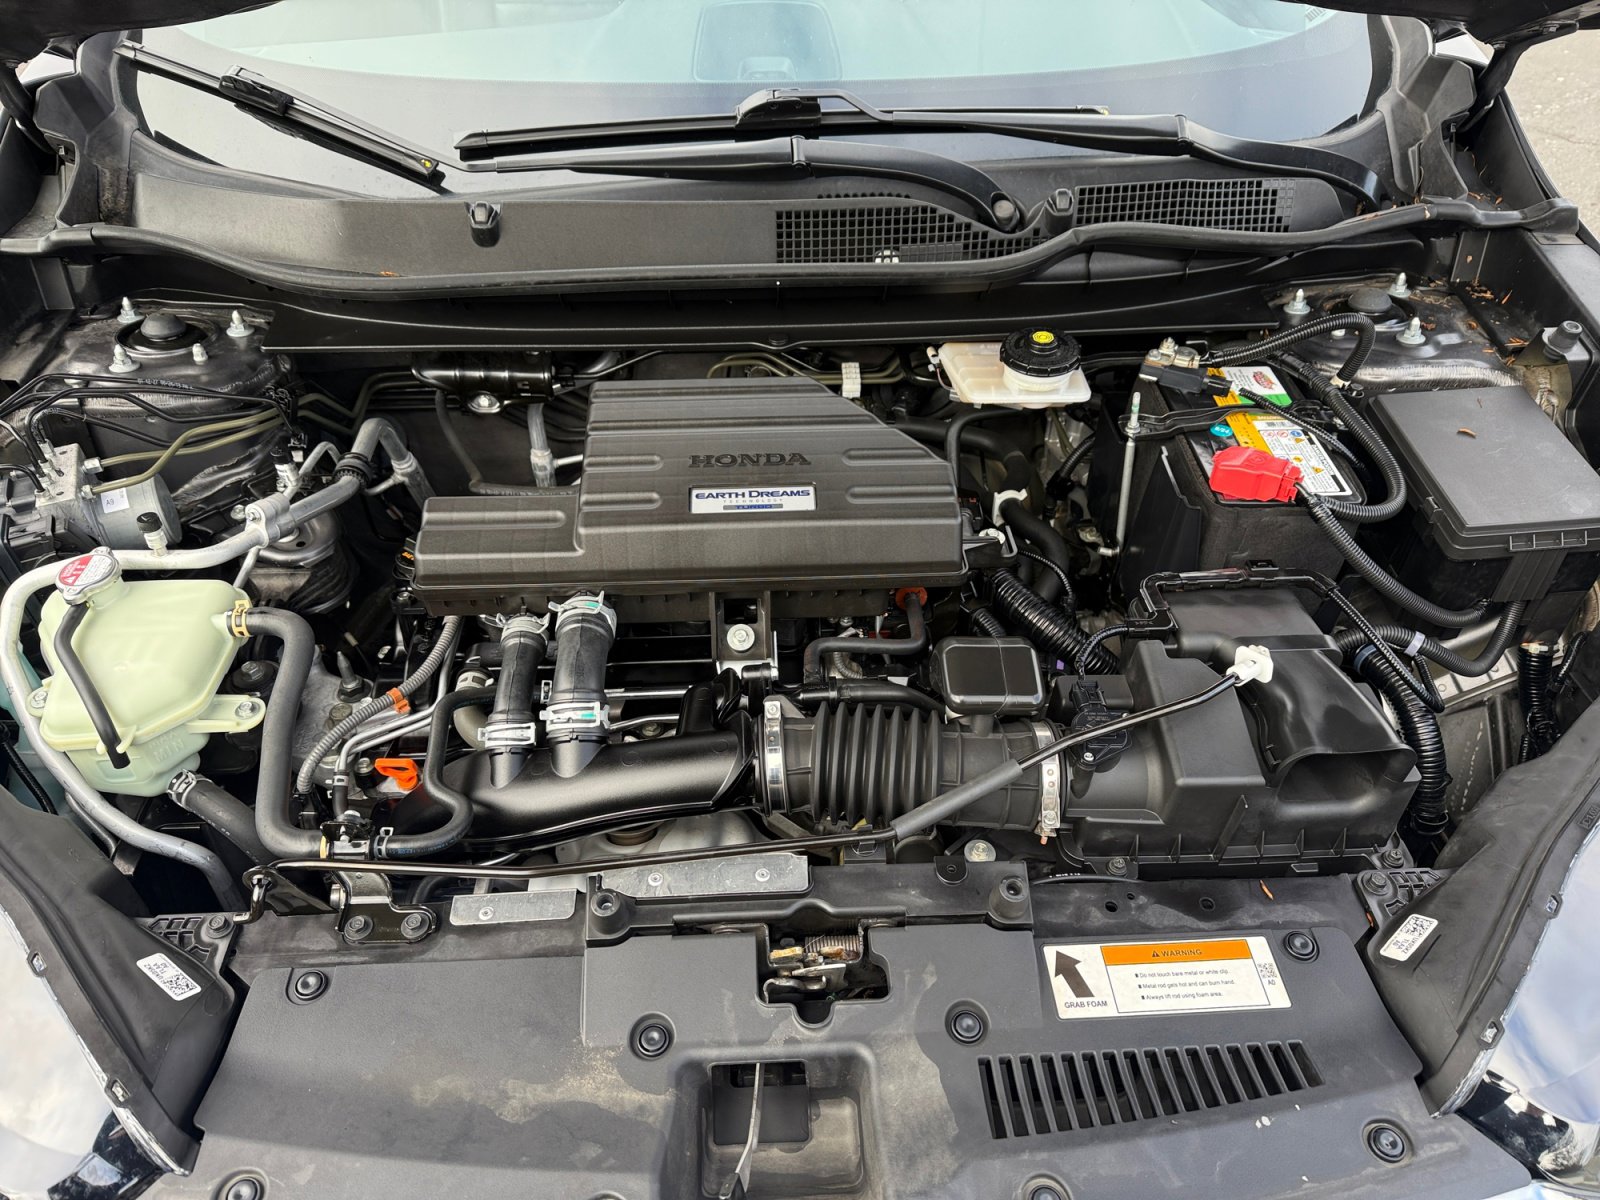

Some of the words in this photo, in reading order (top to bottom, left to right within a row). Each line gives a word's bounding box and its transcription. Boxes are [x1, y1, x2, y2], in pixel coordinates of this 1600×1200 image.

[688, 453, 812, 468] HONDA
[695, 491, 746, 500] EARTH
[748, 490, 811, 498] DREAMS
[1161, 949, 1202, 957] WARNING
